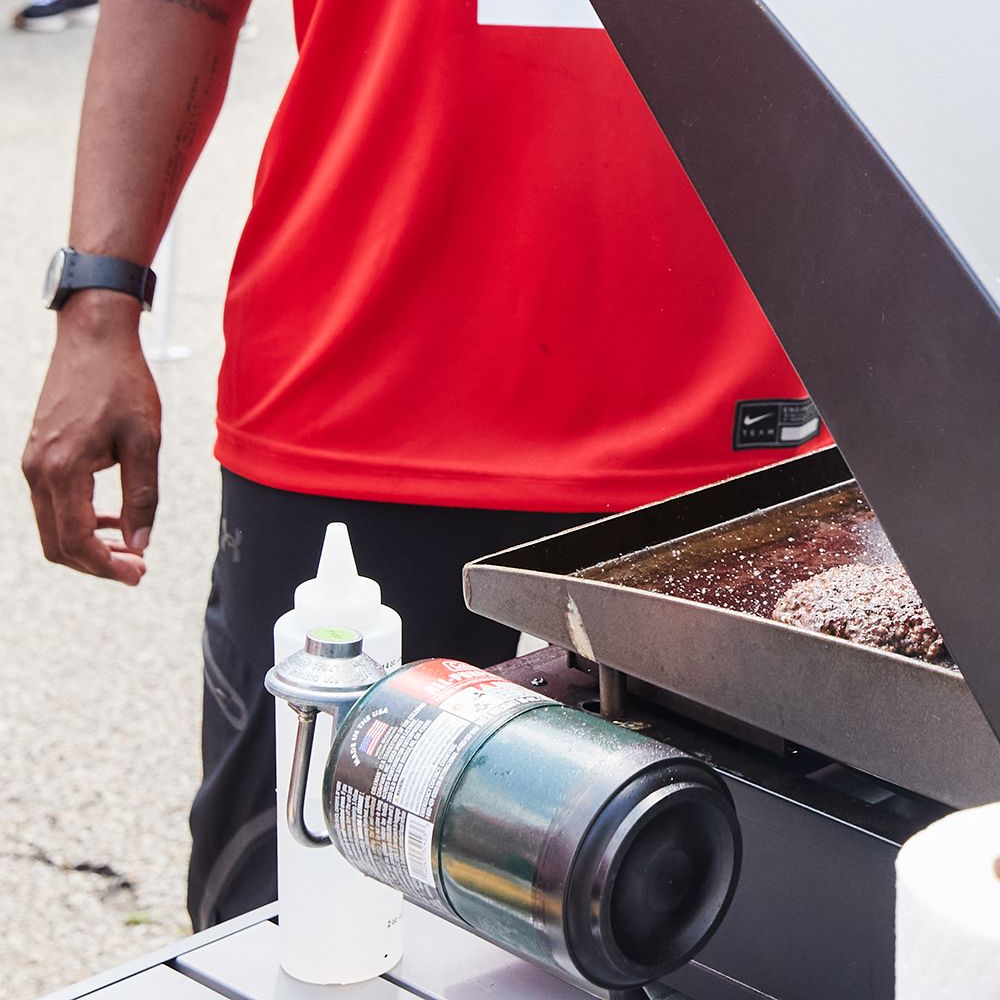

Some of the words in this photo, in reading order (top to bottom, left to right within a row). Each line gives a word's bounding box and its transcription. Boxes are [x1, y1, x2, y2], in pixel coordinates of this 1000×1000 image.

[371, 706, 388, 718] USA
[351, 730, 360, 741] IN
[350, 742, 361, 767] MADE
